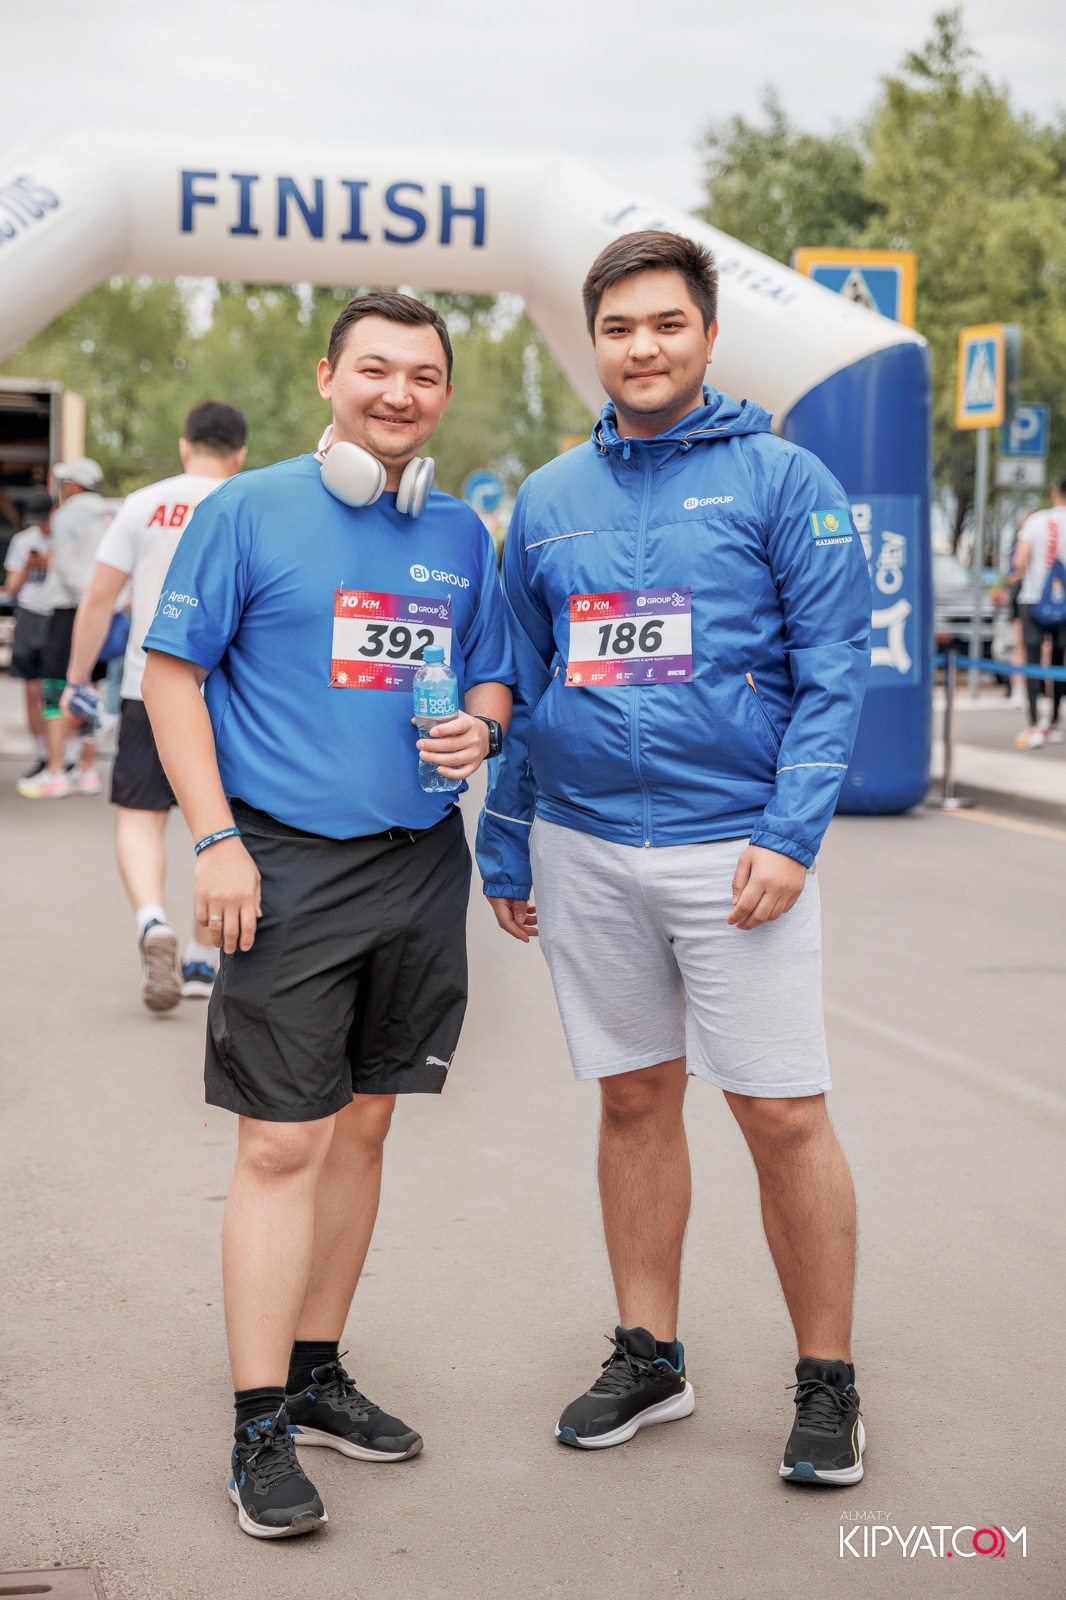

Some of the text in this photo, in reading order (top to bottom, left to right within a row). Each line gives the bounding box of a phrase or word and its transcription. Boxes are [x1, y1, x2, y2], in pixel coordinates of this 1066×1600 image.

[181, 170, 486, 247] FINISH
[1009, 407, 1039, 455] P
[699, 496, 734, 507] GROUP
[147, 504, 195, 528] AB
[431, 569, 470, 590] GROUP
[168, 591, 199, 607] Arena
[341, 595, 381, 609] 10 KM
[576, 599, 610, 612] 10 KM
[163, 604, 182, 620] City
[419, 606, 439, 614] GROUP
[358, 624, 434, 660] 392
[598, 619, 664, 656] 186
